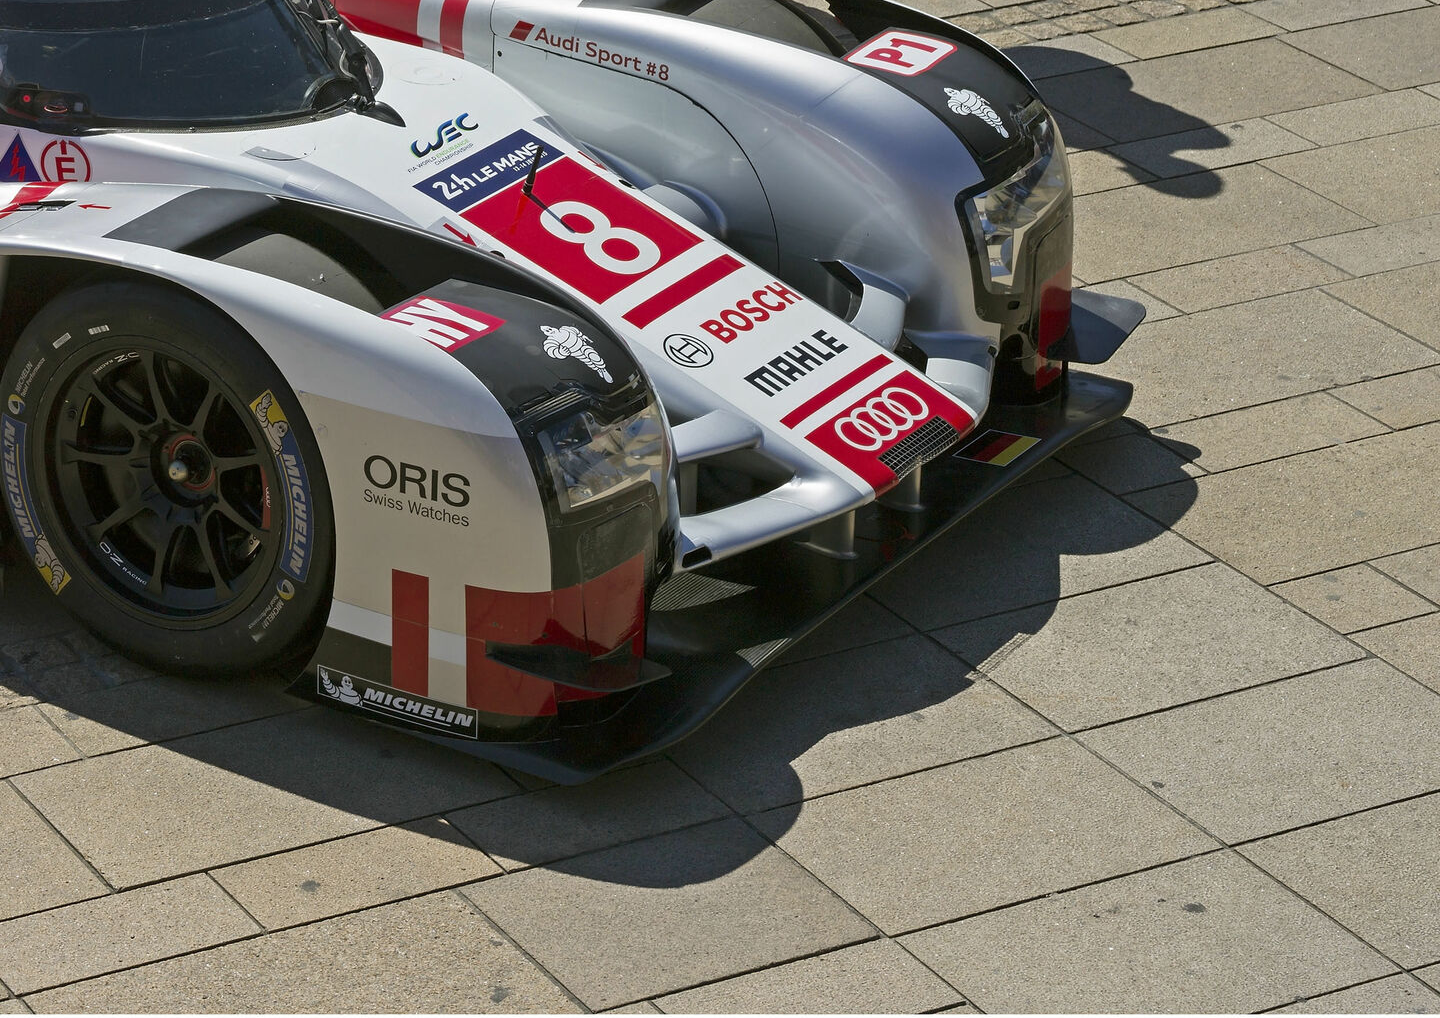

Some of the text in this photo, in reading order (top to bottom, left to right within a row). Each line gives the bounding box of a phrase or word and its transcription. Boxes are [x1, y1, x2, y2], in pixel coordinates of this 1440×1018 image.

[535, 27, 669, 81] Audi Sport #8
[864, 38, 938, 68] P1
[411, 113, 478, 158] WEC
[55, 156, 78, 182] E
[432, 174, 477, 200] 24h
[471, 165, 498, 183] LE
[492, 141, 540, 172] MANS
[539, 200, 661, 275] 8
[389, 298, 489, 348] HY
[699, 281, 803, 345] BOSCH
[744, 329, 849, 397] MAHLE
[3, 421, 37, 539] MICHELIN
[363, 454, 471, 509] ORIS
[280, 453, 308, 576] MICHELIN
[363, 488, 471, 528] Swiss Watches
[122, 566, 148, 586] RACING
[363, 687, 474, 728] MICHELIN
